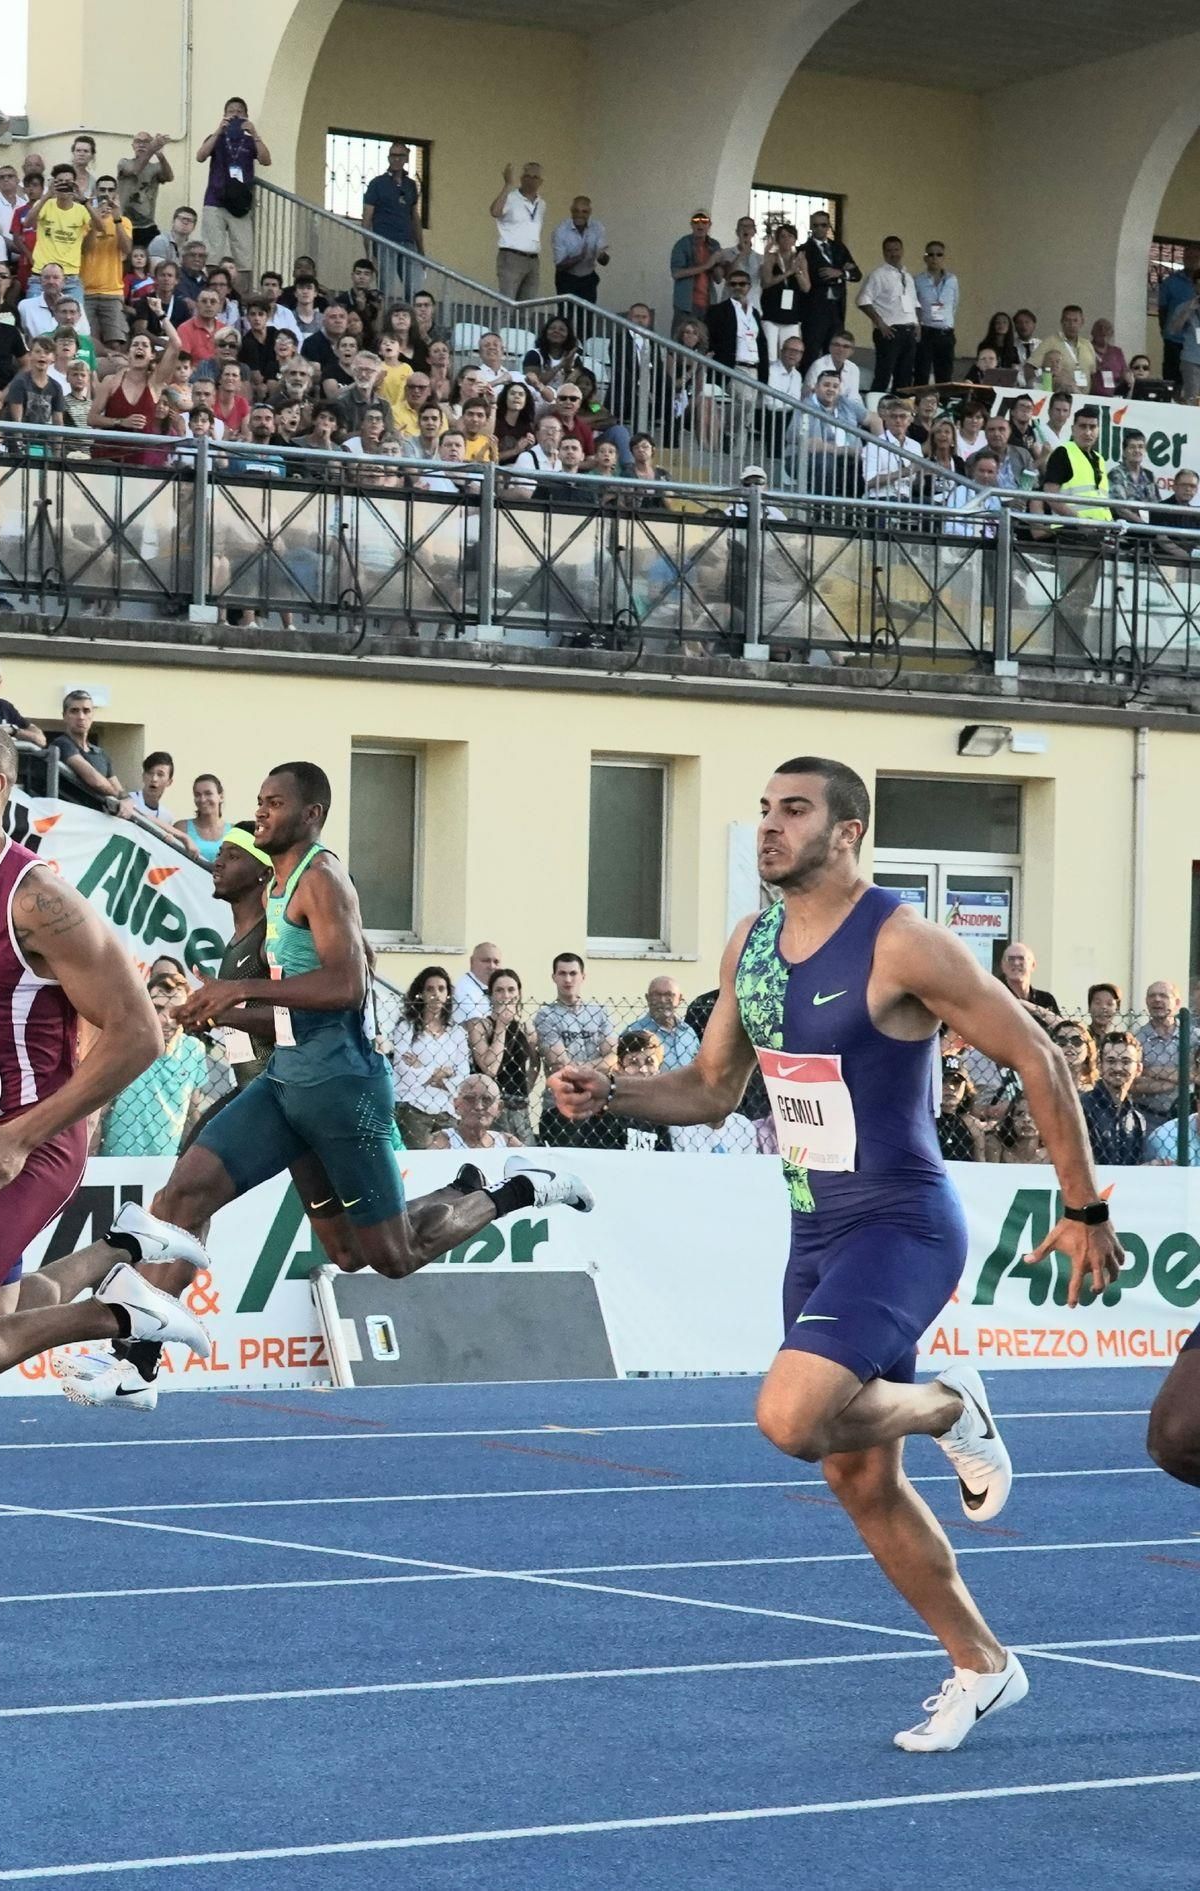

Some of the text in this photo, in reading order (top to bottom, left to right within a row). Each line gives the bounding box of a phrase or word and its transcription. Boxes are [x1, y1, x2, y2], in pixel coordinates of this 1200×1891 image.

[777, 1094, 824, 1127] GEMILI
[929, 1327, 970, 1357] AL
[977, 1328, 1089, 1358] PREZZO
